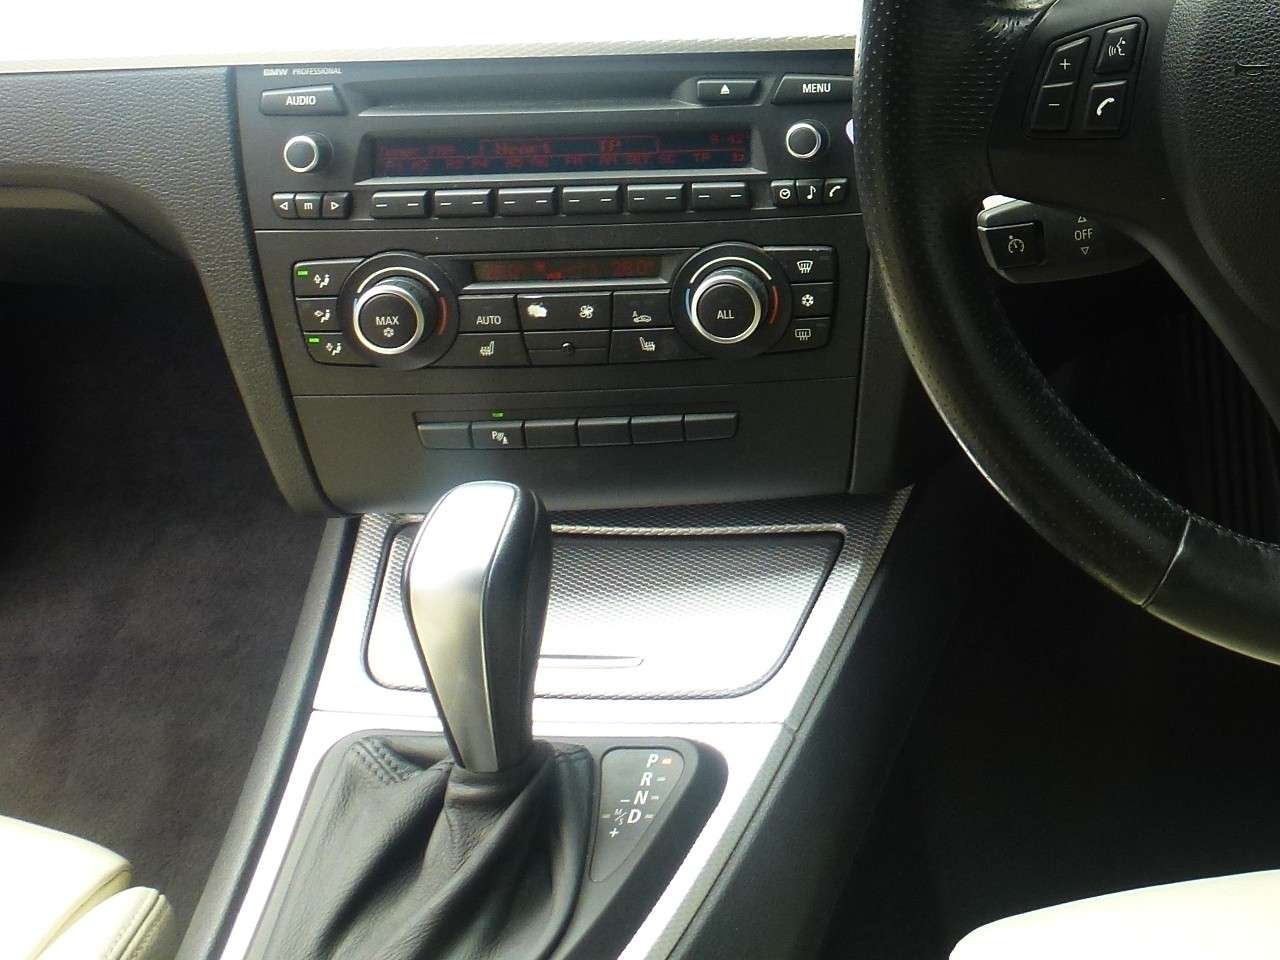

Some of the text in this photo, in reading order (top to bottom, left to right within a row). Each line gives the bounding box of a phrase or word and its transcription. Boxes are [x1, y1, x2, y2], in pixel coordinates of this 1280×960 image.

[802, 82, 832, 94] MENU
[285, 95, 317, 107] AUDIO
[1074, 228, 1094, 241] OFF
[375, 315, 400, 326] MAX
[476, 315, 502, 326] AUTO
[716, 309, 735, 320] ALL
[646, 753, 660, 768] P
[640, 771, 653, 786] R
[633, 790, 649, 805] N
[627, 808, 642, 824] D
